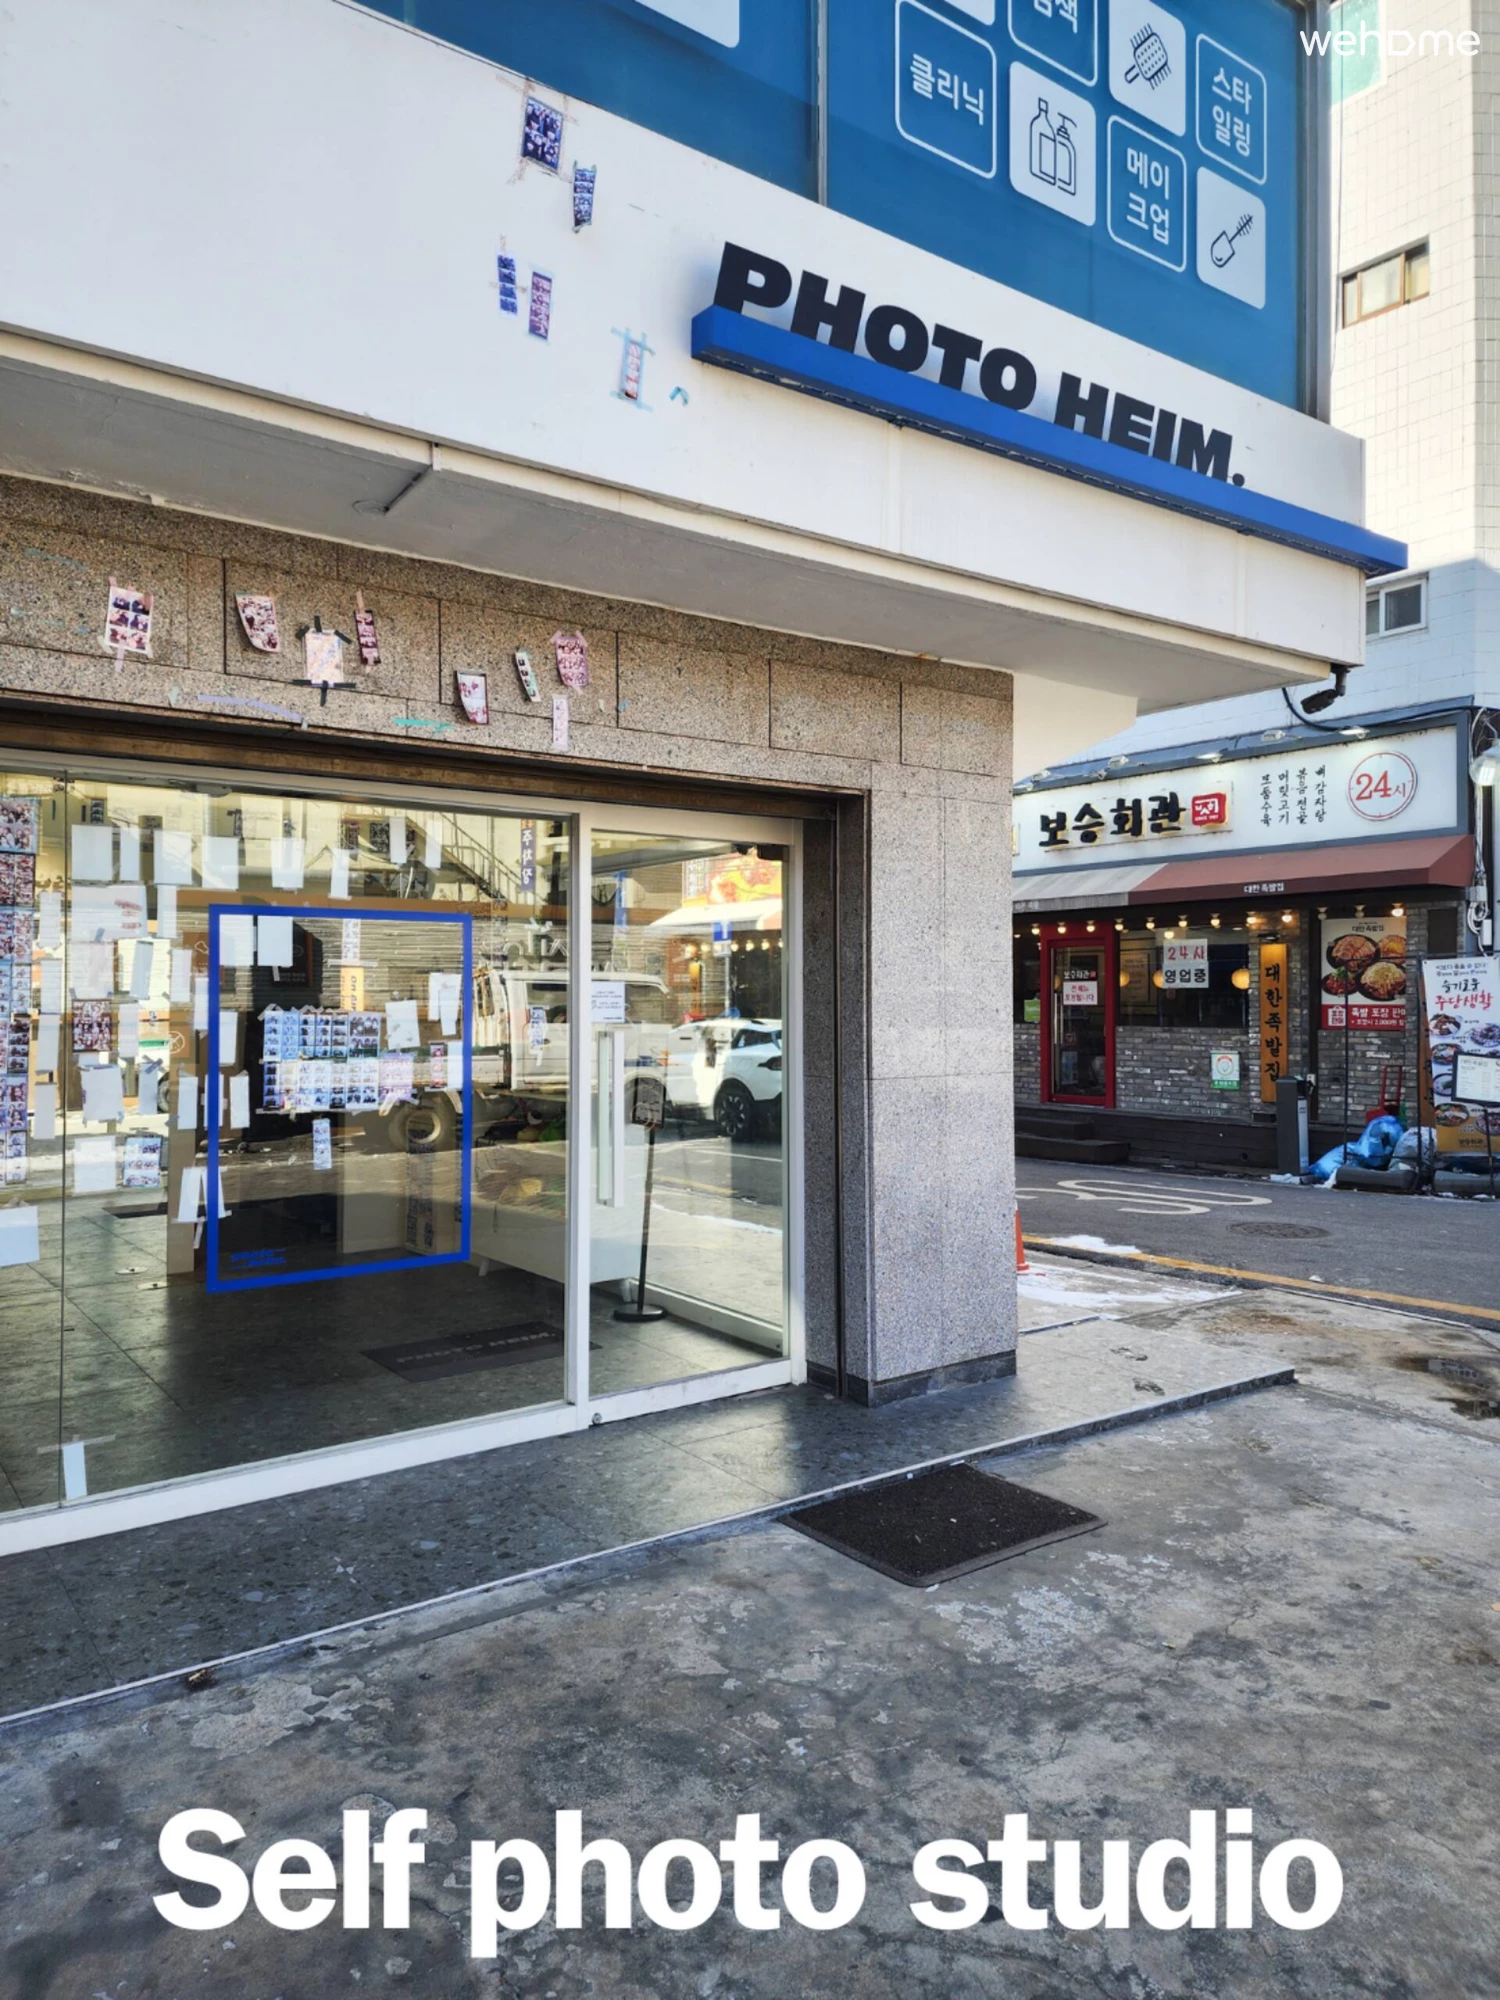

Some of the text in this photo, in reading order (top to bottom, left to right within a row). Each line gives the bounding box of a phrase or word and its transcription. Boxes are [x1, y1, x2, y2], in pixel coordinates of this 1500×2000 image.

[910, 53, 984, 126] 클리닉
[1211, 67, 1252, 109] 스타
[1212, 106, 1251, 157] 일링
[1126, 147, 1170, 199] 메이
[1126, 193, 1170, 246] 크업
[713, 241, 1246, 487] PHOTO HEIM.
[1278, 769, 1290, 825] 머릿고기
[1355, 770, 1406, 801] 24시
[1038, 781, 1187, 847] 보승회관
[1164, 969, 1206, 984] 영업중
[1168, 945, 1205, 960] 24시
[1263, 963, 1283, 1083] 대한족발집
